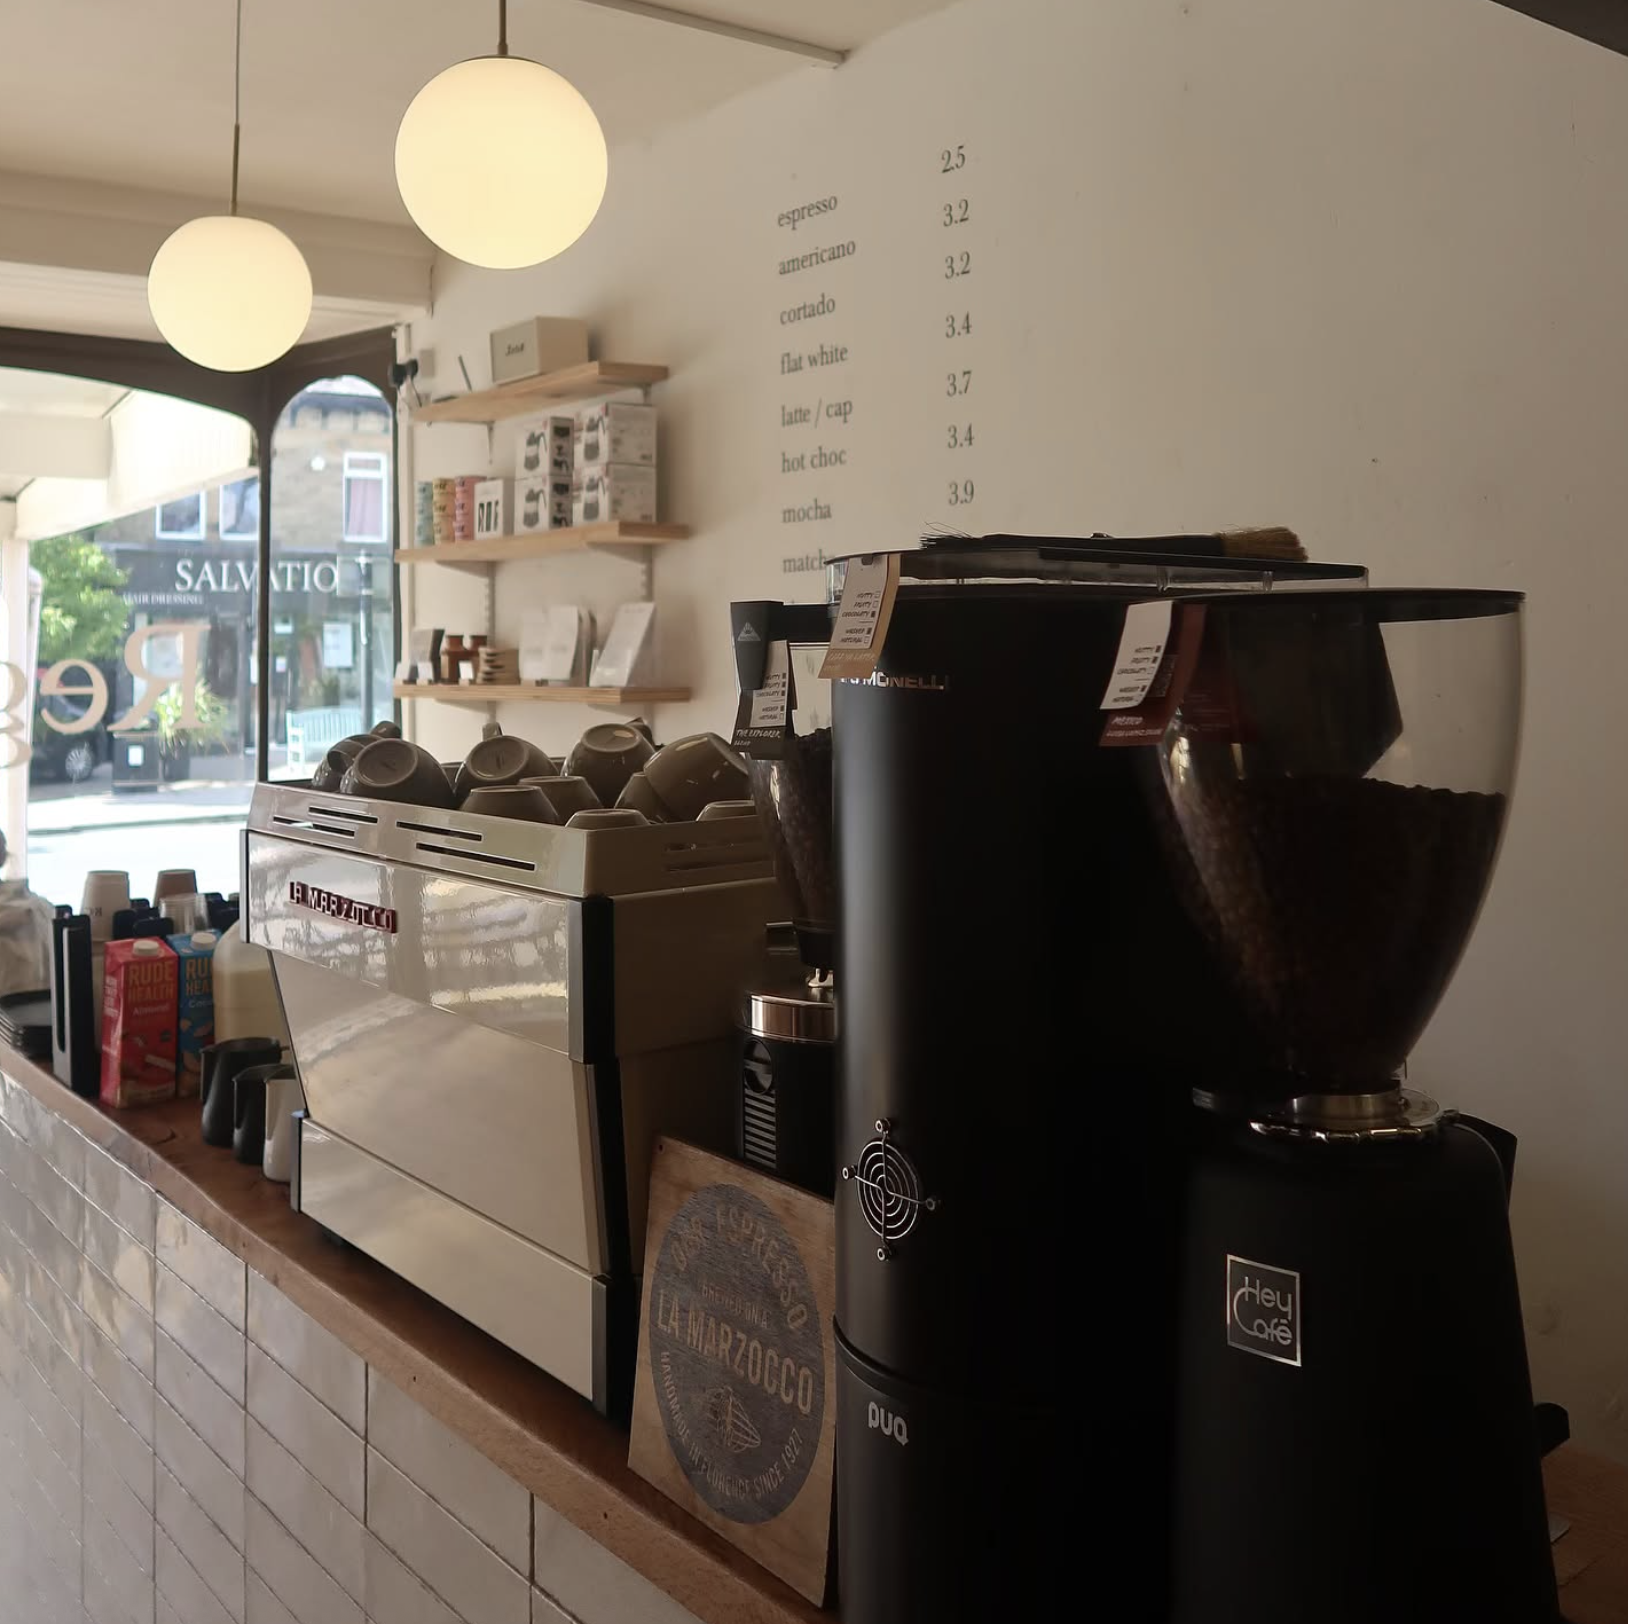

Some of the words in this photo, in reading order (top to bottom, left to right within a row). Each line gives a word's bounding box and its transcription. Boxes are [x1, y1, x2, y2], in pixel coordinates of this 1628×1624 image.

[940, 145, 966, 173] 2.5
[777, 195, 838, 230] espresso
[943, 199, 970, 227] 3.2
[778, 240, 857, 276] americano
[944, 251, 971, 280] 3.2
[779, 293, 836, 326] cortado
[945, 311, 972, 339] 3.4
[780, 352, 804, 376] flat
[807, 344, 848, 369] white
[946, 370, 972, 398] 3.7
[781, 404, 811, 427] latte
[825, 400, 853, 424] cap
[947, 423, 975, 449] 3.4
[781, 451, 806, 474] hot
[810, 446, 847, 470] choc
[948, 480, 975, 506] 3.9
[782, 499, 832, 524] mocha
[783, 549, 836, 574] match
[128, 960, 174, 986] RUDE
[127, 983, 175, 1003] HEALTH
[716, 1203, 809, 1331] ESPRESSO
[1244, 1276, 1292, 1321] Hey
[657, 1289, 679, 1341] LA
[686, 1298, 813, 1415] MARZOCCO
[660, 1351, 692, 1447] HANDMADE
[688, 1441, 701, 1466] IN
[700, 1458, 750, 1500] FLORENCE
[753, 1460, 786, 1500] SINCE
[780, 1427, 804, 1470] 1927
